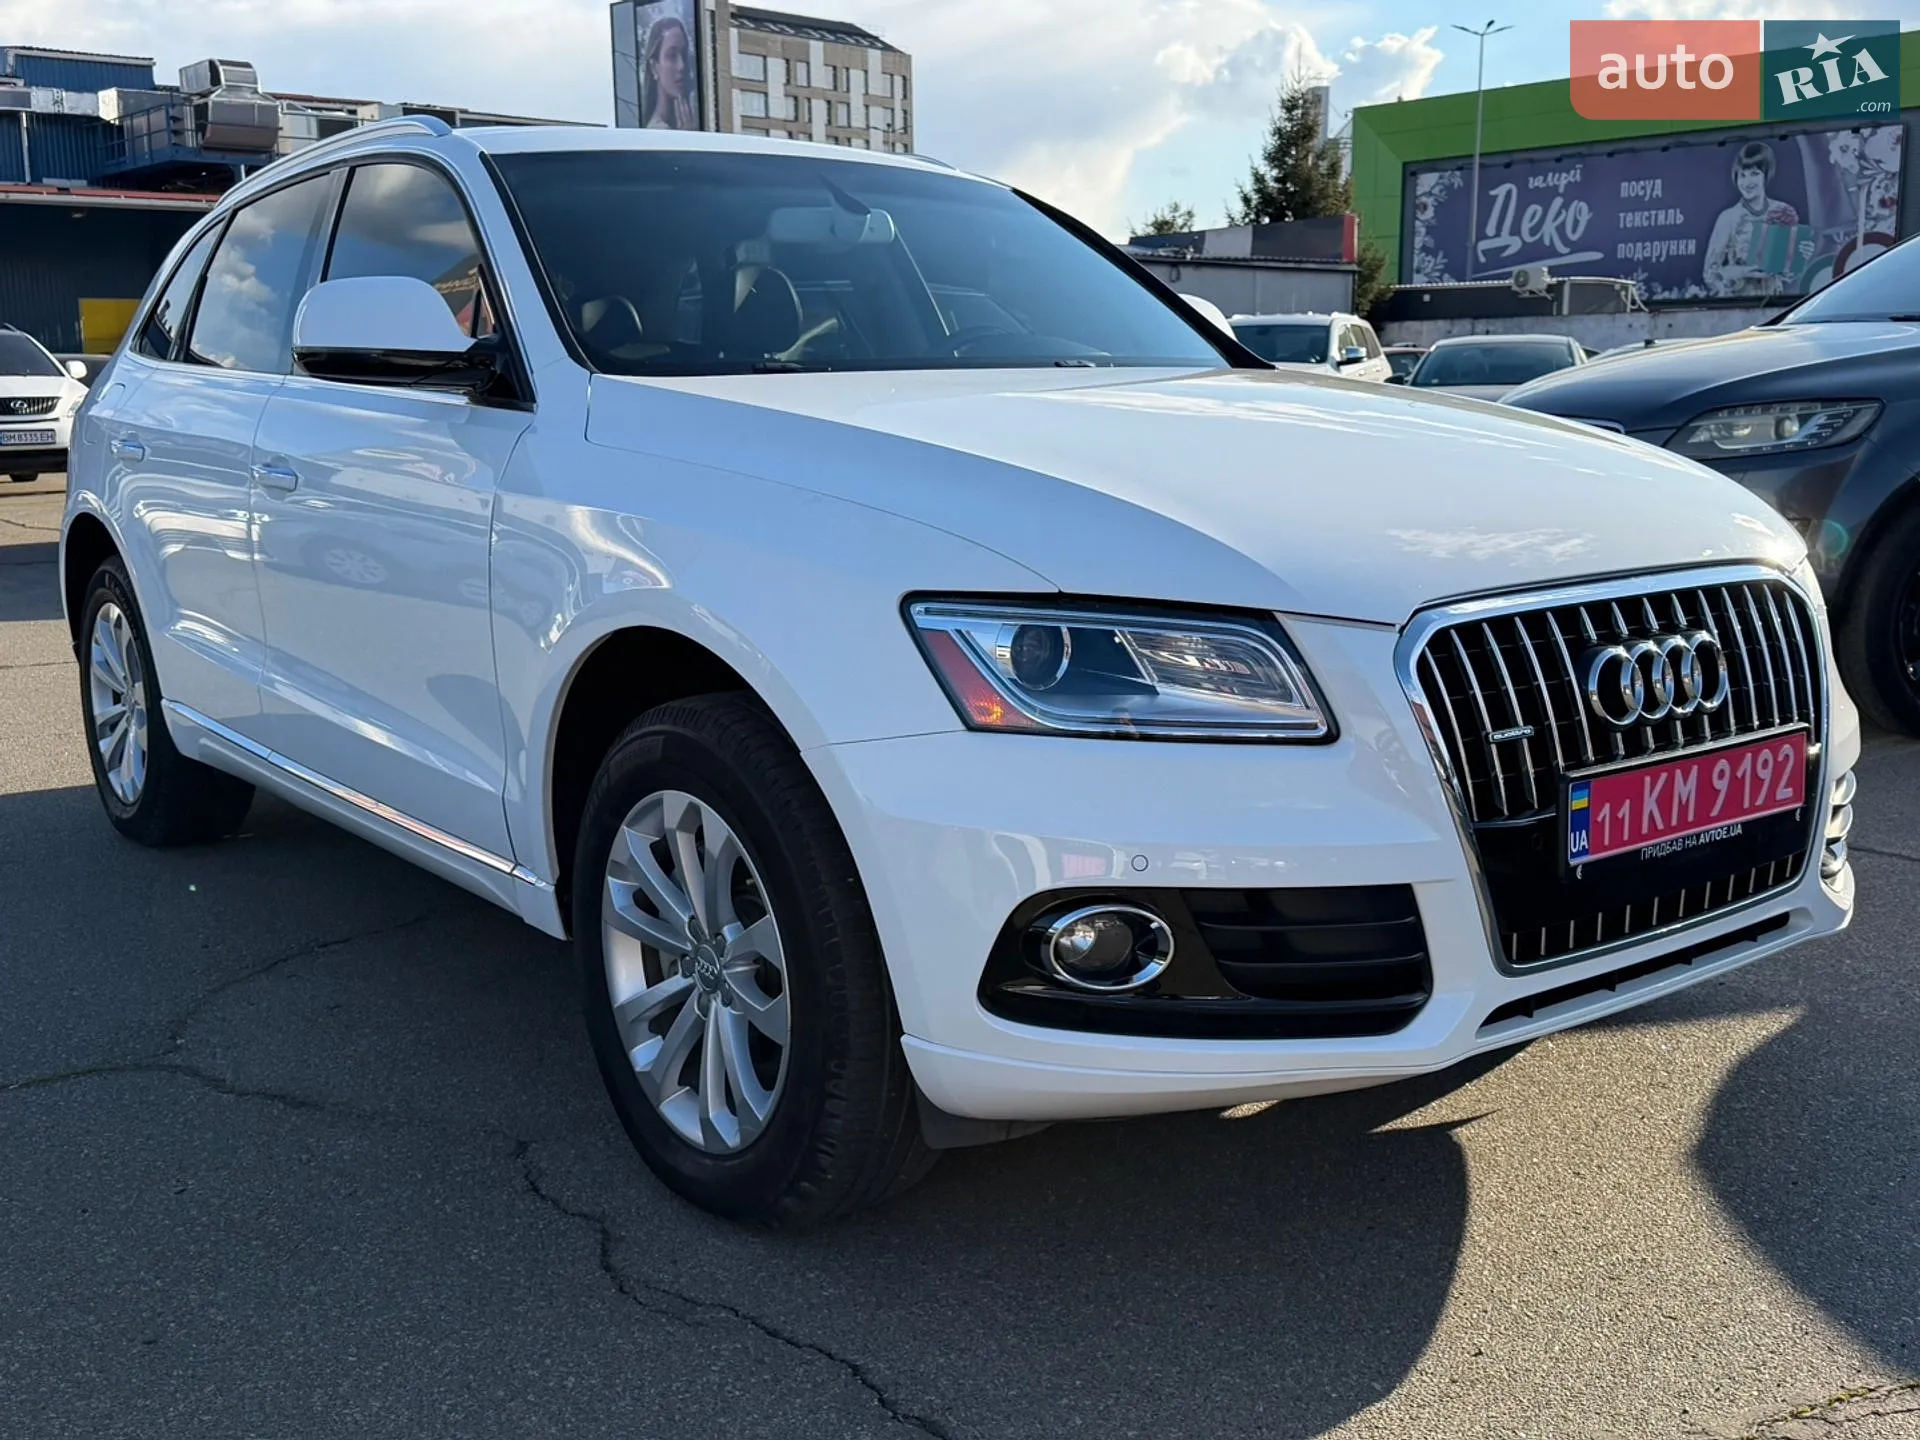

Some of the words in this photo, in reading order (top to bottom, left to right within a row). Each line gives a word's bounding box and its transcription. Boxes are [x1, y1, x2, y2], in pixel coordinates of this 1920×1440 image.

[1620, 178, 1662, 201] посуд
[1477, 183, 1593, 263] Деко
[1619, 208, 1685, 229] текстиль
[1617, 238, 1697, 263] подарунки
[1597, 799, 1632, 846] 11
[1641, 764, 1699, 835] KM
[1709, 743, 1796, 818] 9192
[1570, 830, 1589, 854] UA
[1640, 838, 1684, 861] ПРИДБАВ
[1699, 823, 1743, 845] AVTOE.UA
